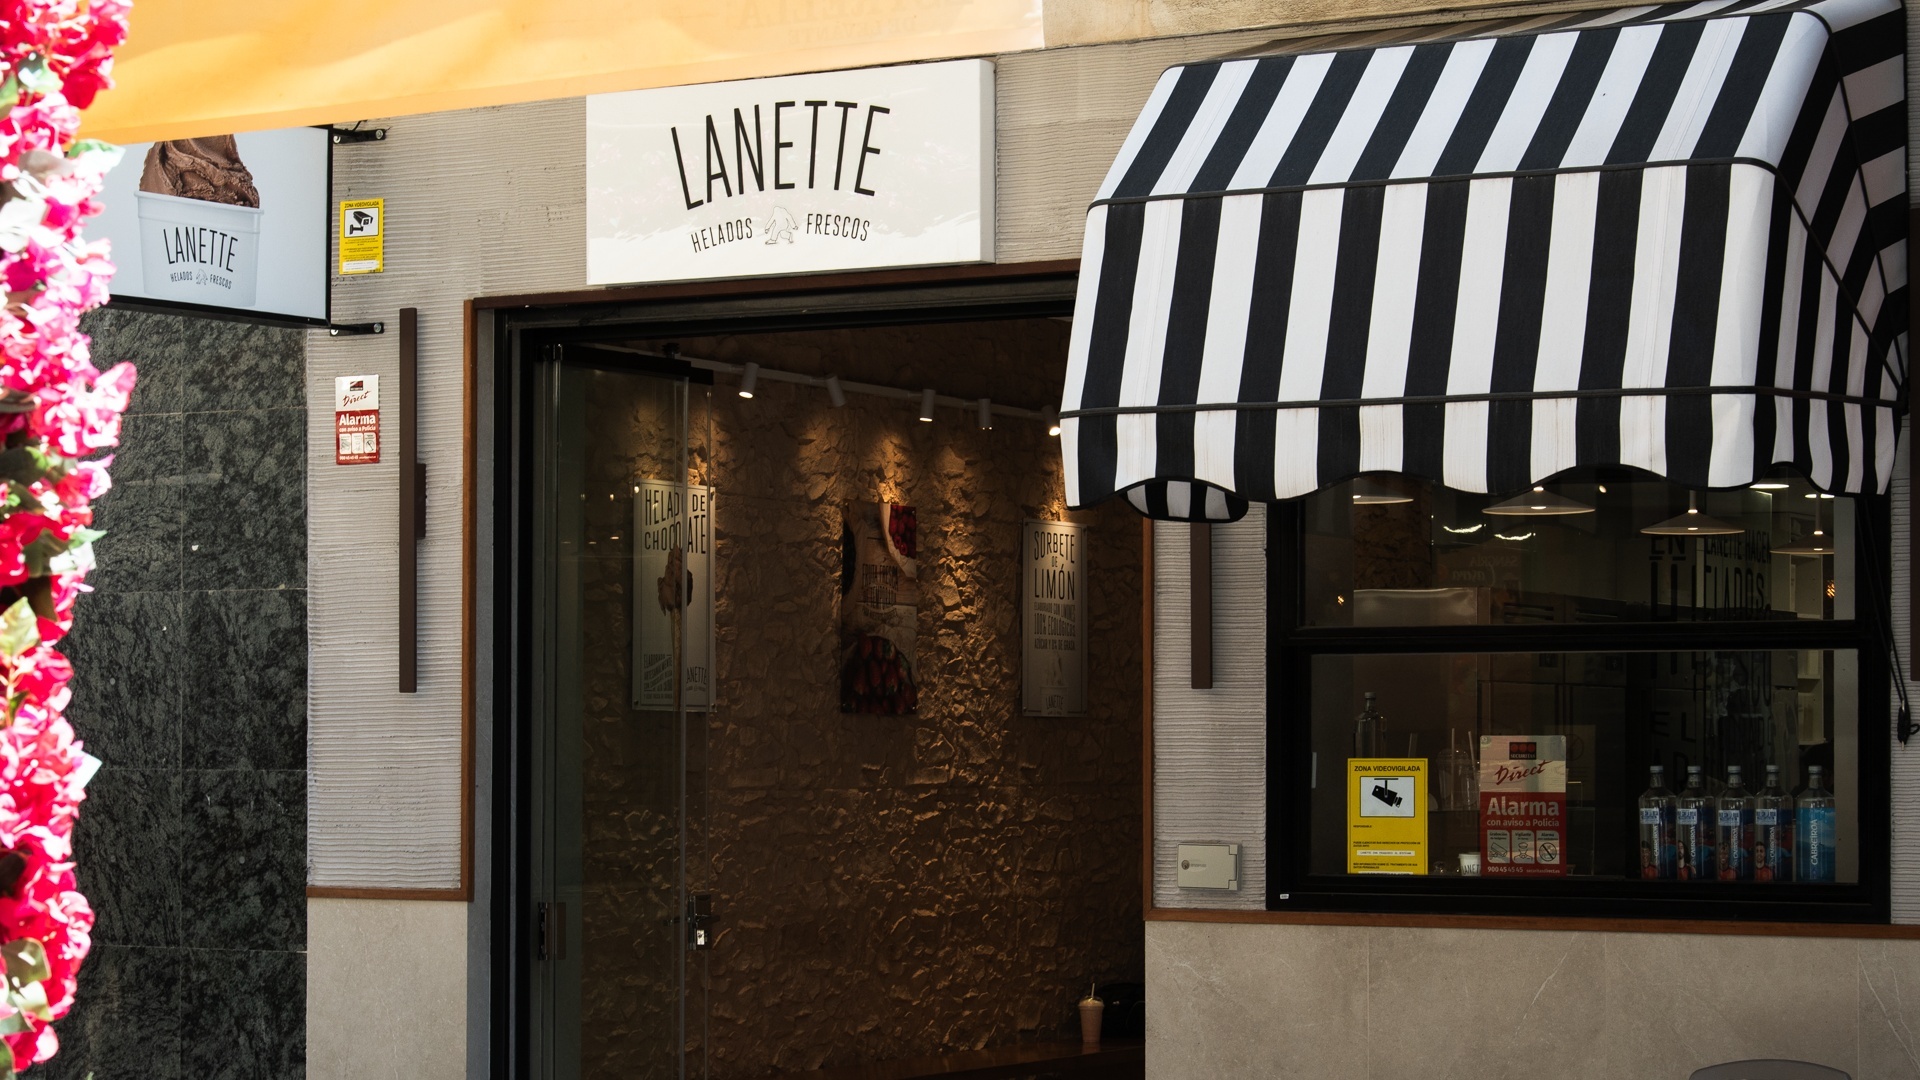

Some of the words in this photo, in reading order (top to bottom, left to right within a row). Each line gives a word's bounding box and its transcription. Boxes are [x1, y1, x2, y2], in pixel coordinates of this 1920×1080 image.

[670, 100, 891, 211] LANETTE
[690, 217, 753, 253] HELADOS
[806, 213, 871, 242] FRESCOS
[163, 226, 239, 273] LANETTE
[170, 271, 193, 283] HELADOS
[209, 274, 233, 290] FRESCOS
[342, 390, 372, 407] Direct
[339, 413, 376, 426] Alarma
[645, 489, 684, 526] HELAD
[692, 494, 706, 512] DE
[645, 514, 706, 554] CHOCOATE
[1034, 530, 1075, 564] SORBETE
[1051, 555, 1058, 568] DE
[1034, 563, 1075, 601] LIMÓN
[686, 666, 707, 685] ANETTE
[1494, 759, 1553, 785] Direct
[1486, 796, 1560, 816] Alarma
[1486, 819, 1501, 827] con
[1502, 817, 1524, 827] aviso
[1532, 817, 1560, 827] Policía
